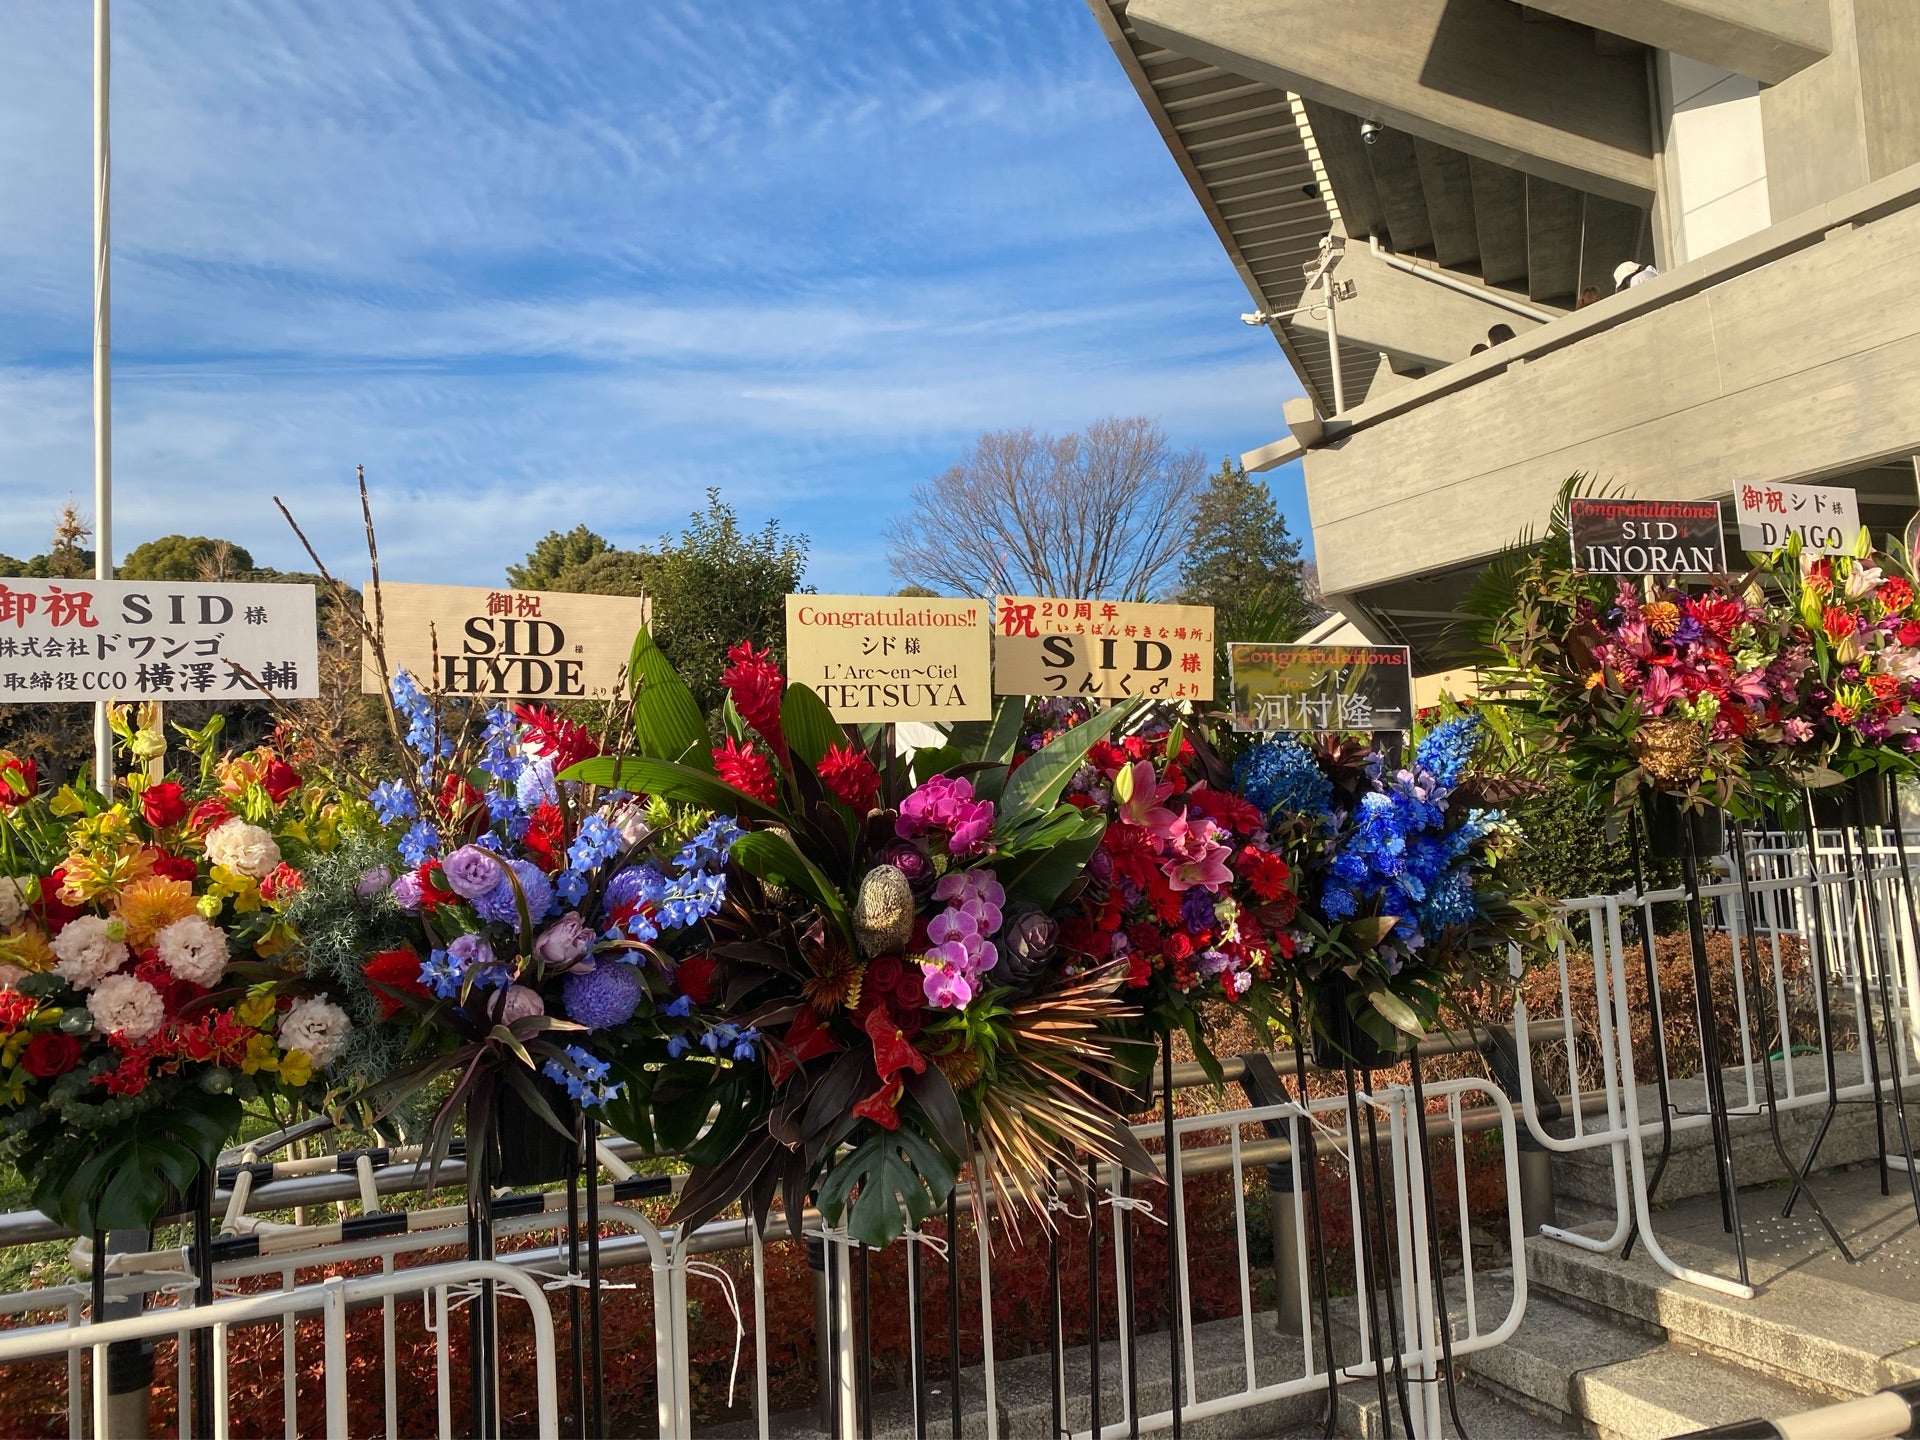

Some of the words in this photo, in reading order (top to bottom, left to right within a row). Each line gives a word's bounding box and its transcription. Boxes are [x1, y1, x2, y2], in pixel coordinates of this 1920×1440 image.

[1572, 500, 1717, 521] Congratulations!
[1741, 484, 1787, 514] 御祝
[1791, 493, 1827, 514] シド
[1831, 502, 1844, 515] 様
[1622, 521, 1678, 540] SID
[1761, 522, 1843, 549] DAIGO
[1586, 546, 1714, 572] INORAN
[0, 584, 99, 629] 御祝
[121, 593, 234, 625] SID
[243, 605, 268, 626] 様
[485, 591, 542, 618] 御祝
[1041, 602, 1120, 622] 20周年
[798, 607, 977, 629] Congratulations!!
[998, 597, 1040, 639] 祝
[1045, 619, 1213, 642] 「いちばん好きな場所」
[463, 616, 565, 656] SID
[862, 635, 896, 656] シド
[905, 637, 921, 655] 様
[1041, 635, 1173, 672] SID
[1180, 652, 1202, 673] 様
[1232, 646, 1407, 669] Congratulations!
[440, 655, 585, 696] HYDE
[1309, 669, 1349, 690] シド
[816, 684, 967, 708] TETSUYA
[1175, 682, 1199, 698] より
[1254, 692, 1402, 730] 河村隆一
